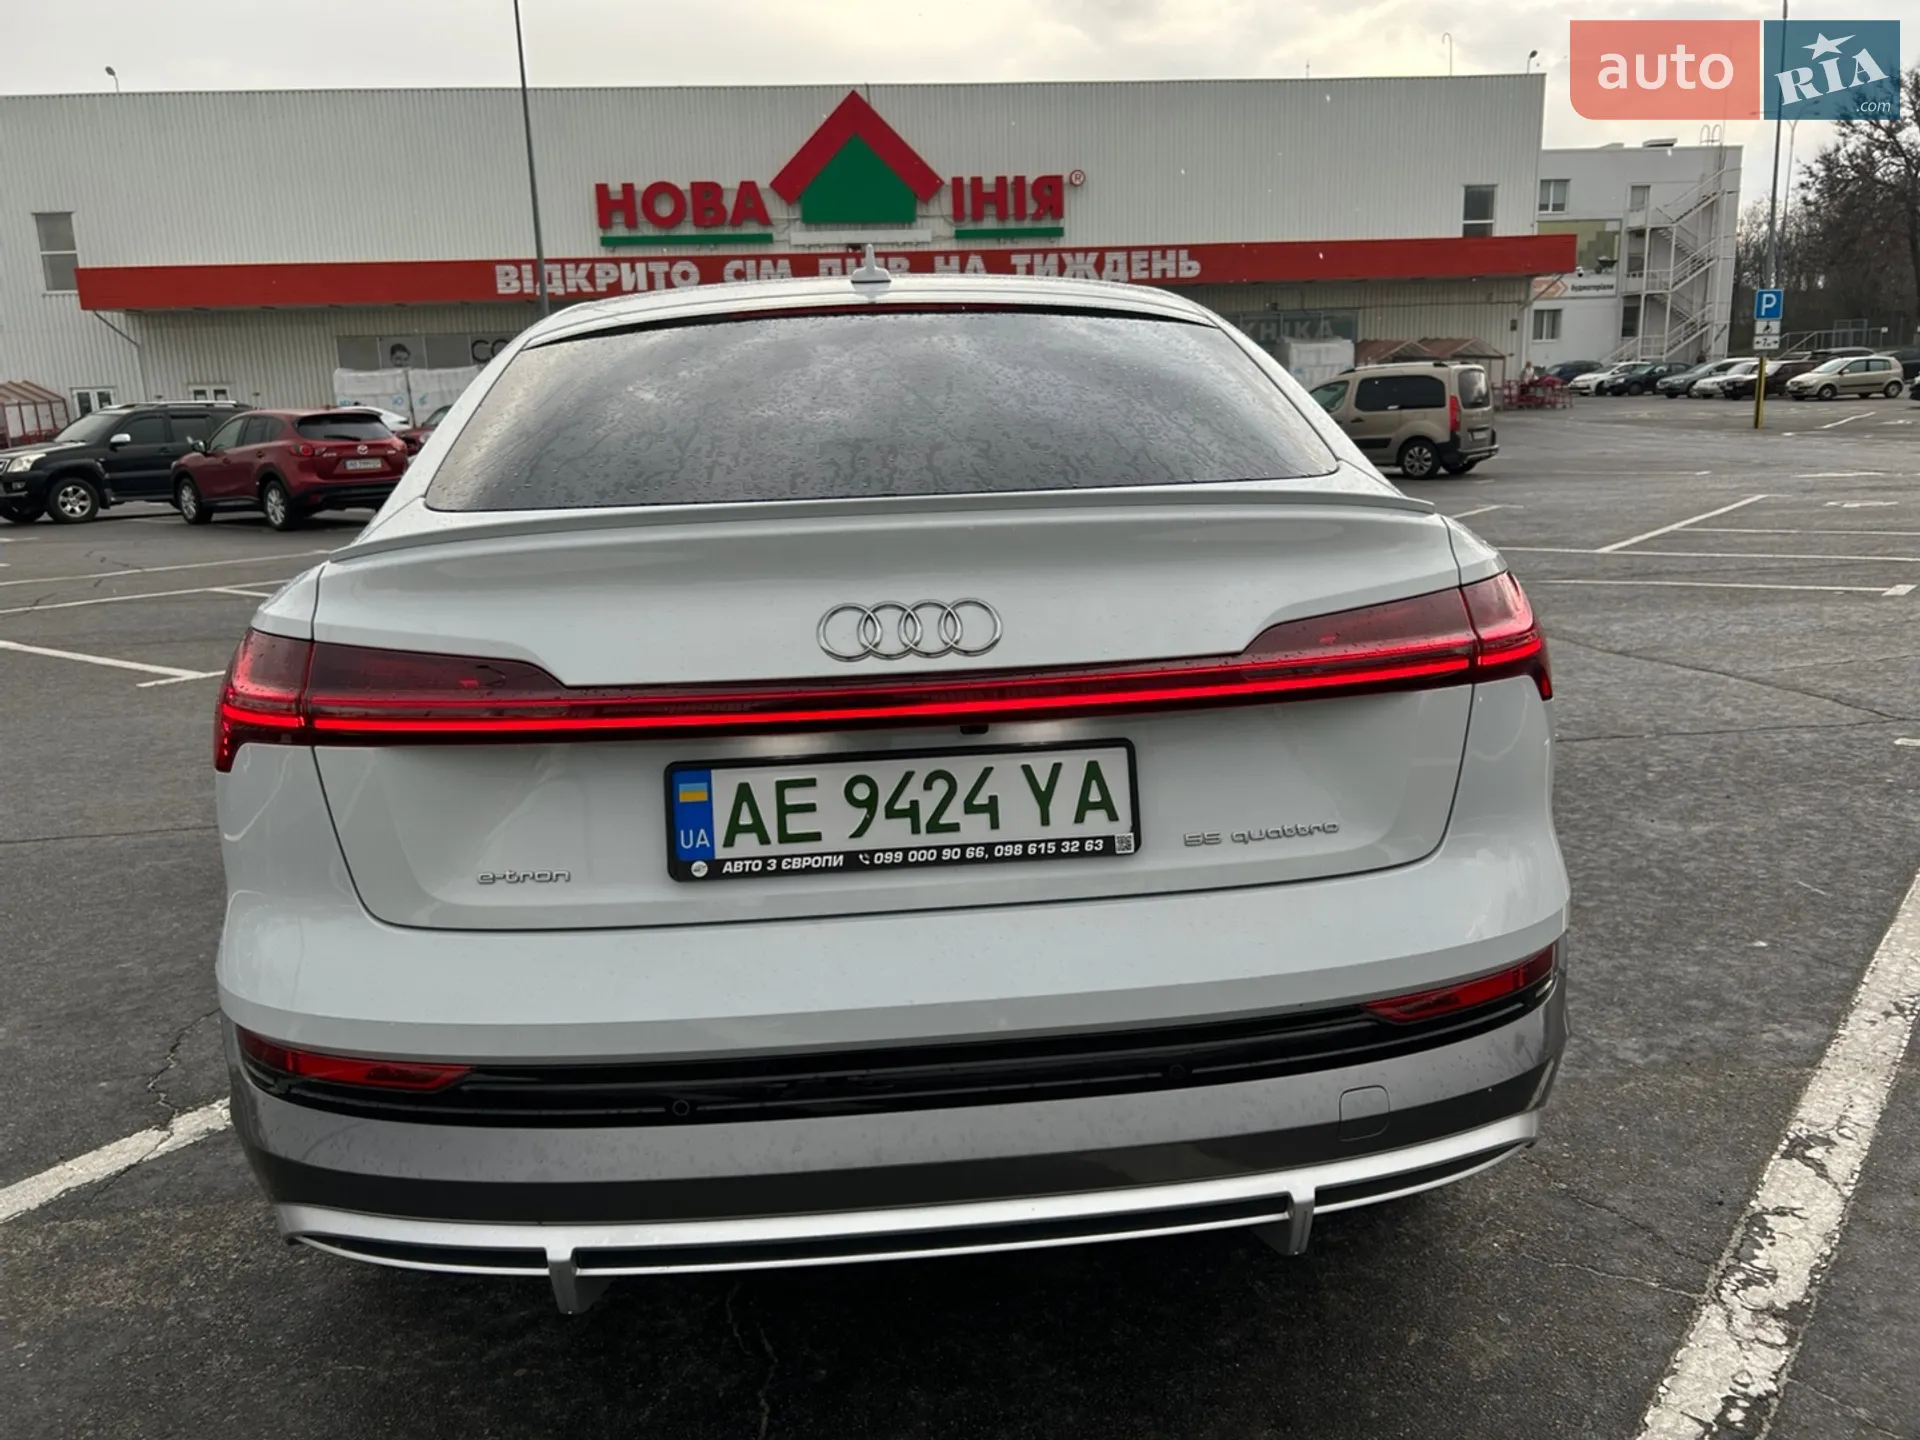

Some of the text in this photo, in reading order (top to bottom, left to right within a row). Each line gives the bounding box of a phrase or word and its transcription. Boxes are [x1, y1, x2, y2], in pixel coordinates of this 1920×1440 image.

[595, 181, 774, 230] НОВА
[495, 260, 700, 295] ВІДКРИТО
[723, 259, 793, 283] СІМ
[934, 254, 988, 275] НА
[1010, 249, 1201, 282] ТИЖДЕНЬ
[1761, 293, 1777, 316] P
[722, 760, 1120, 848] AE 9424 YA
[680, 829, 711, 850] UA
[1231, 821, 1340, 845] quattro
[722, 858, 763, 874] АВТО
[781, 855, 845, 871] ЄВРОПИ
[874, 851, 903, 864] 099
[908, 849, 938, 862] 000
[941, 848, 962, 860] 90
[965, 846, 989, 860] 66,
[994, 844, 1023, 857] 098
[1027, 842, 1056, 855] 615
[1061, 840, 1080, 853] 32
[1085, 839, 1104, 851] 63
[478, 870, 571, 885] e-tron
